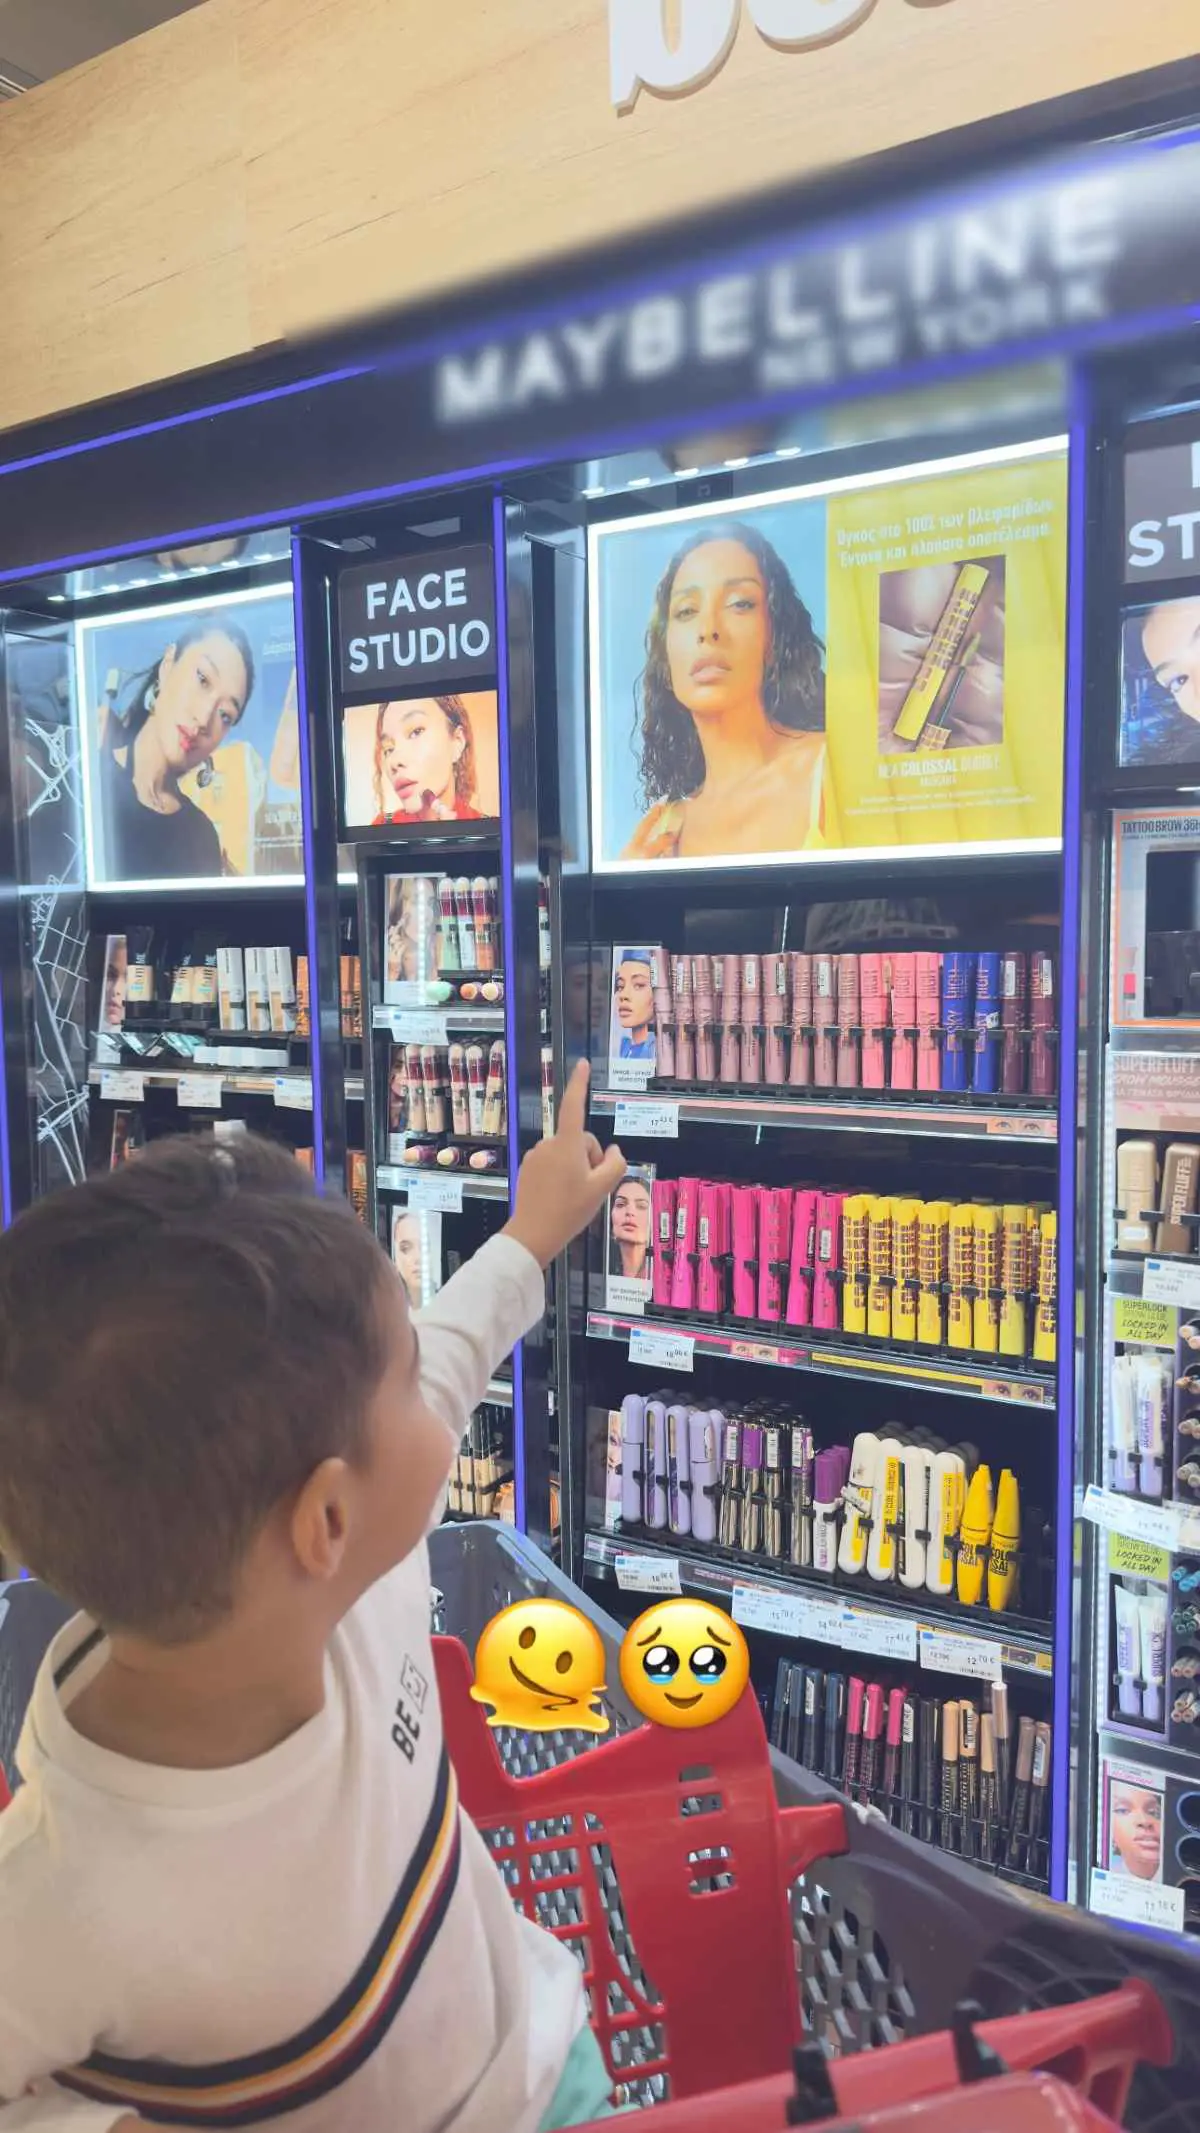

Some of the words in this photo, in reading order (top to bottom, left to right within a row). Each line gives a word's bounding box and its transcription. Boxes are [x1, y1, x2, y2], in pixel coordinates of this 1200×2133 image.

[437, 181, 1122, 418] MAYBELLINE
[760, 327, 902, 387] NEW
[918, 271, 1110, 350] YORK
[366, 568, 468, 620] FACE
[349, 619, 490, 674] STUDIO
[901, 759, 957, 776] COLOSSAL
[946, 969, 961, 999] HIGH
[1116, 1550, 1151, 1562] LOCKED
[391, 1698, 421, 1765] BE
